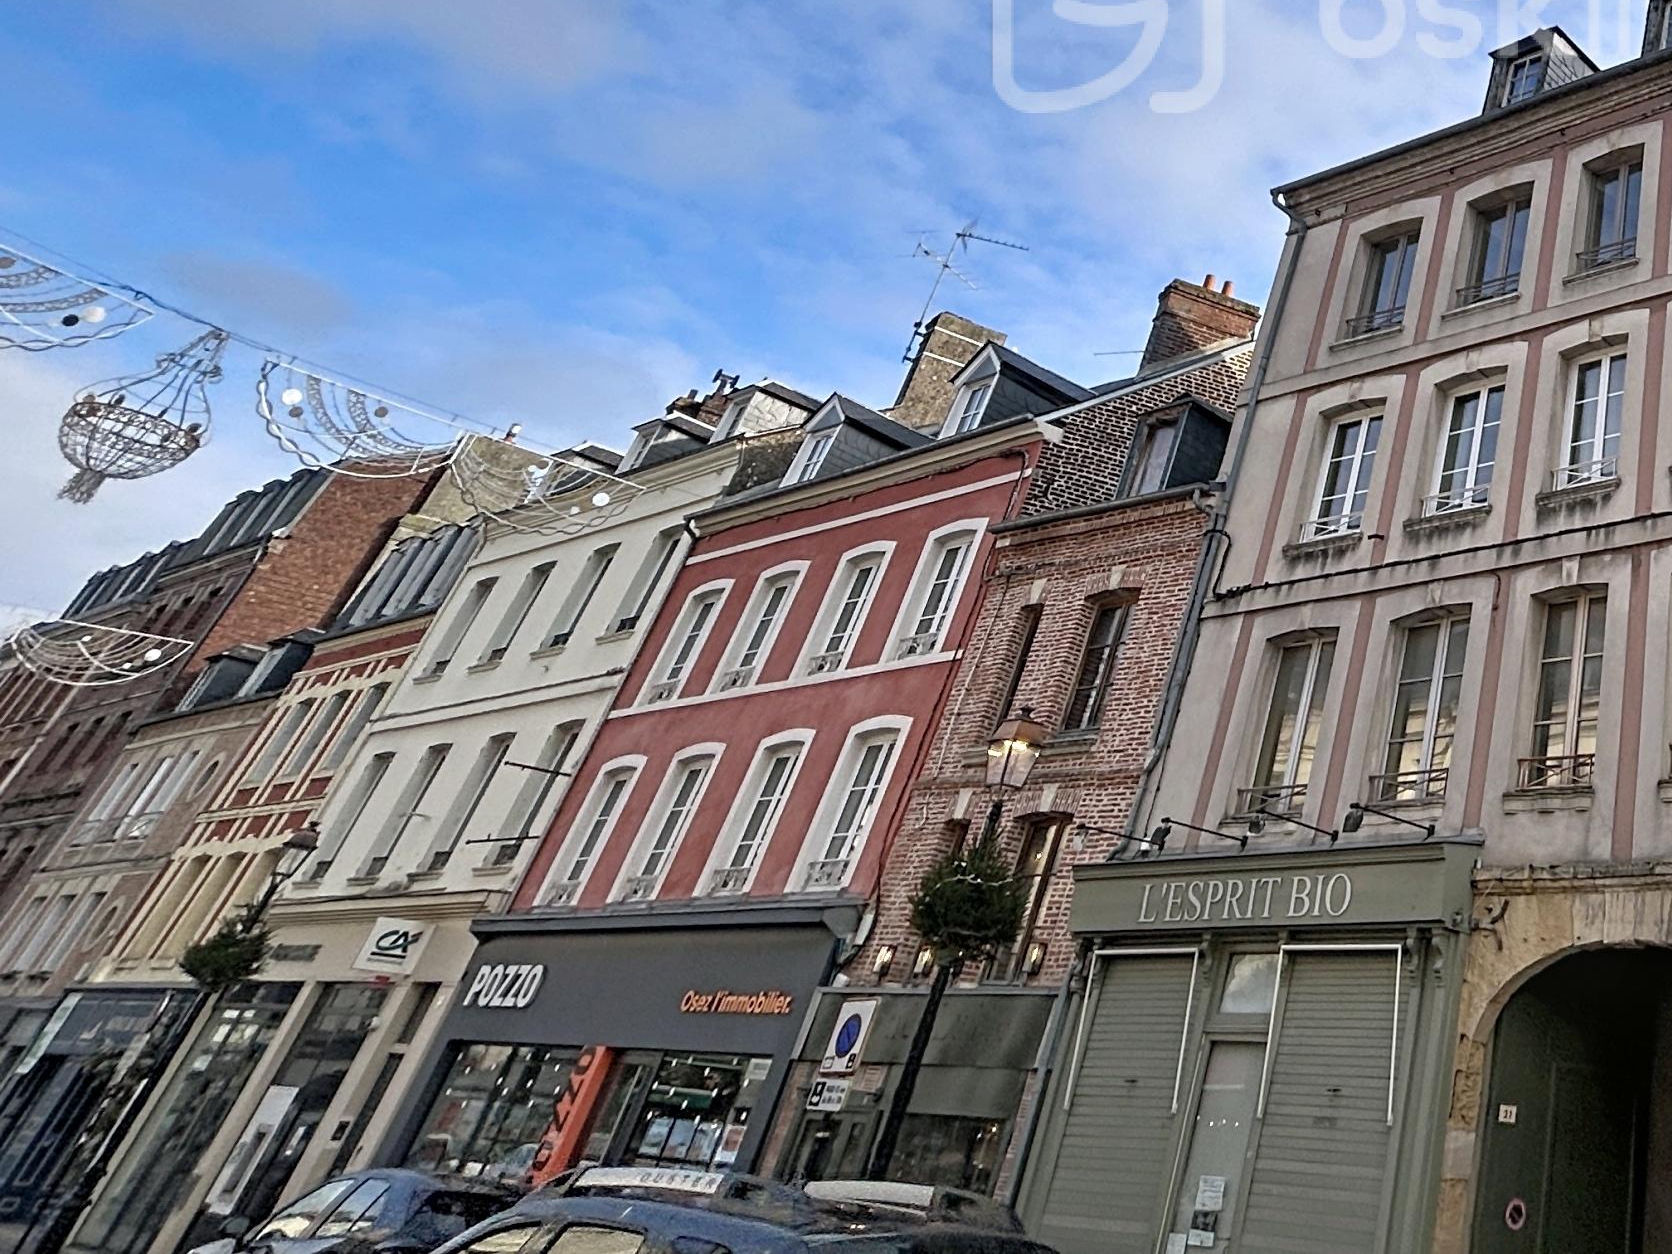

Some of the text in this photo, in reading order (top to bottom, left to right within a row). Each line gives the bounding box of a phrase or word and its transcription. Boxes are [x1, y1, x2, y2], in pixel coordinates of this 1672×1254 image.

[1137, 872, 1353, 923] L'ESPRIT BIO
[462, 963, 546, 1009] POZZO
[681, 989, 713, 1013] Osez
